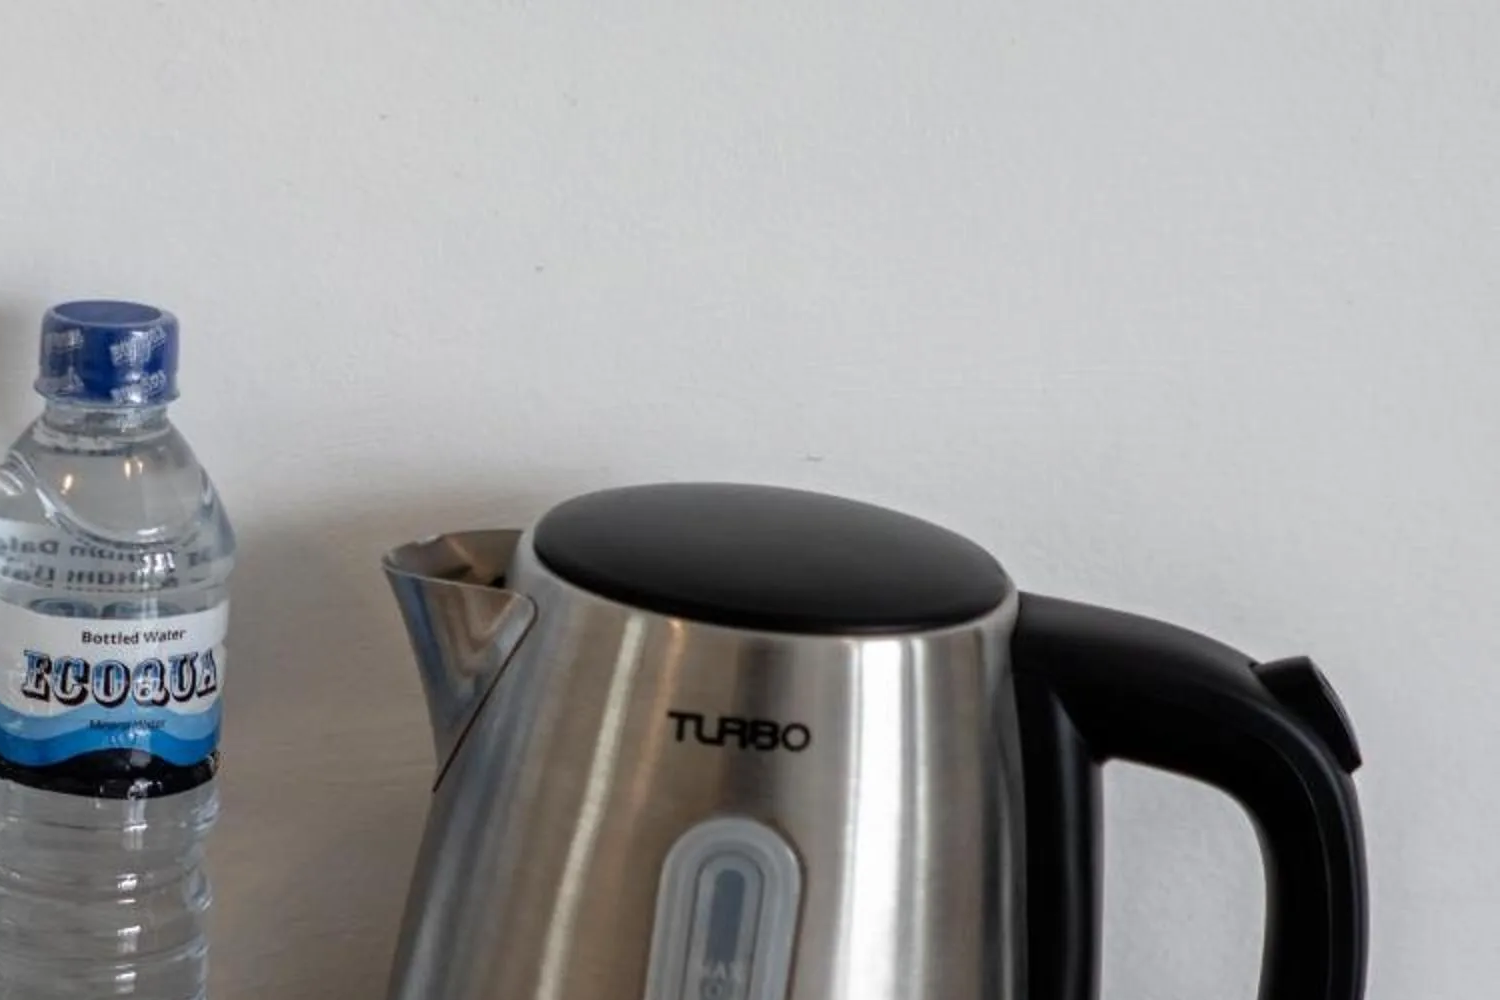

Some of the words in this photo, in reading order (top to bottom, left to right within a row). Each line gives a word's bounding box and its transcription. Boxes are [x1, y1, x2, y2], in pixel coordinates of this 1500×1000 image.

[80, 630, 139, 645] Bottled
[143, 629, 187, 643] Water
[21, 648, 218, 708] ECOQUA
[667, 710, 811, 752] TURBO
